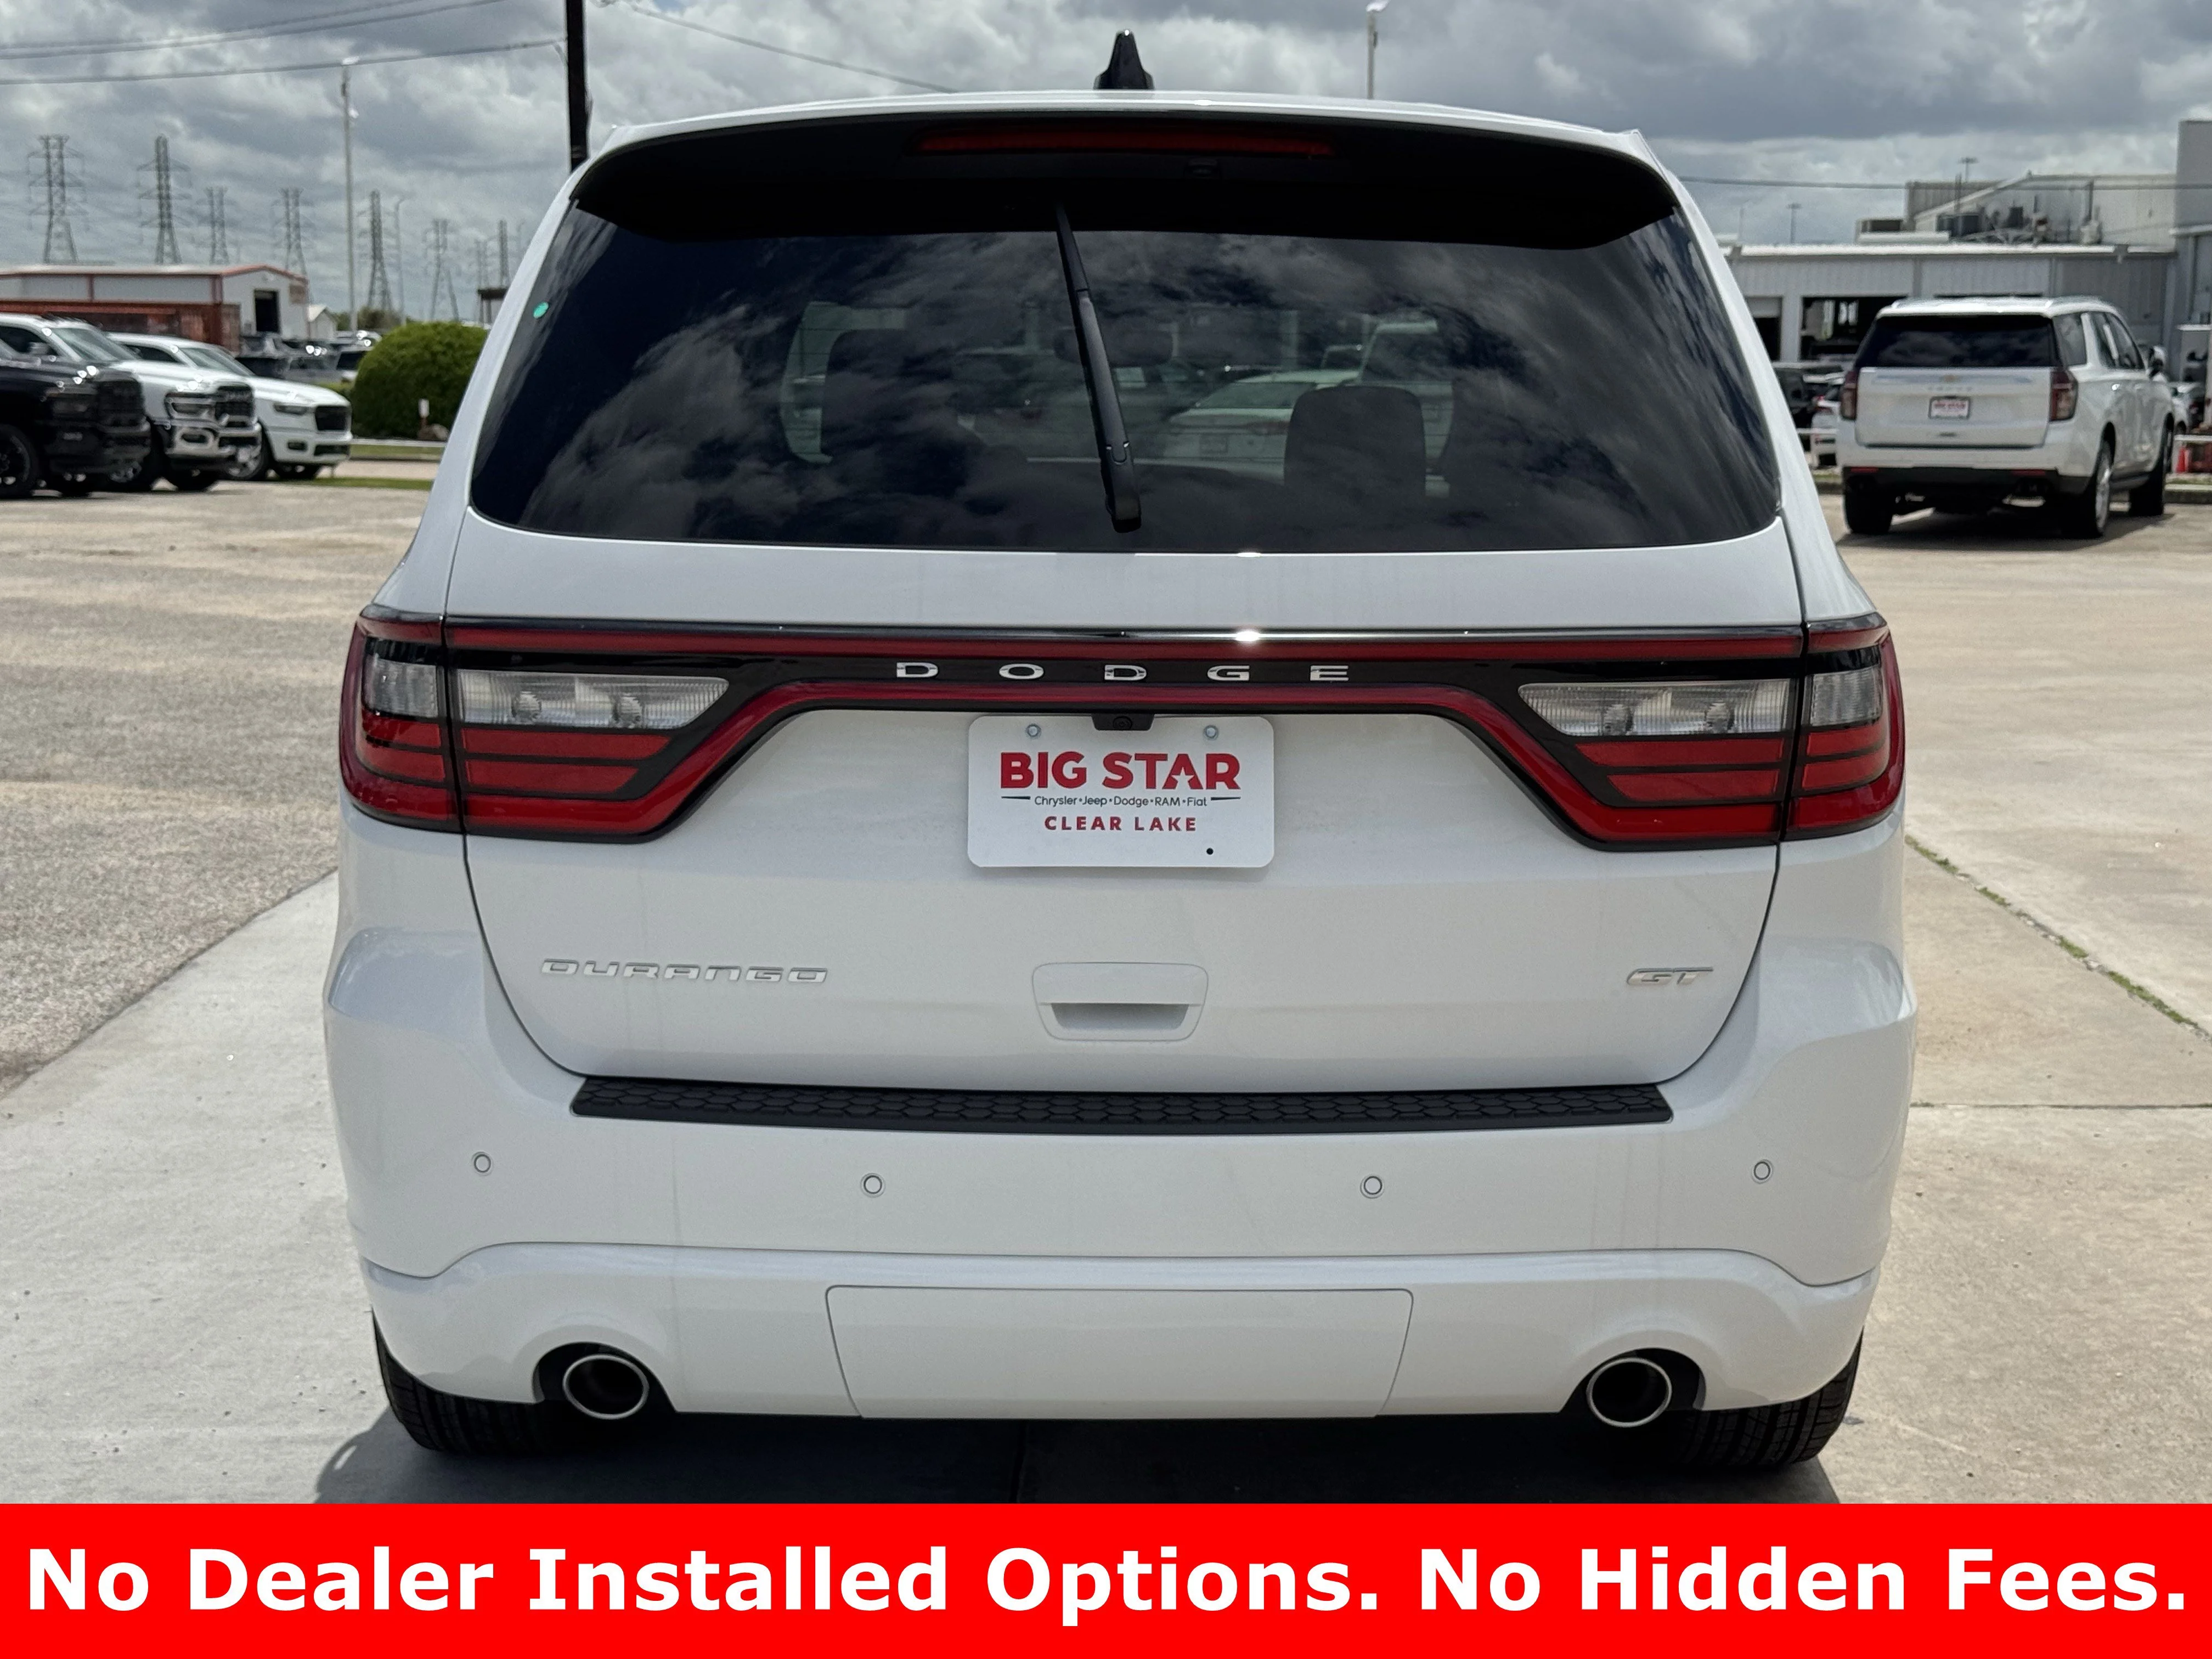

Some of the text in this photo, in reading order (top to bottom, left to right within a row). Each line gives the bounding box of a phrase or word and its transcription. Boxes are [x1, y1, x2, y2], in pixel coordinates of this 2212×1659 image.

[896, 662, 1349, 681] DODGE
[1001, 751, 1240, 789] BIG STAR
[1044, 816, 1197, 831] CLEAR LAKE
[541, 958, 828, 983] DURANGO
[1627, 967, 1714, 986] GT
